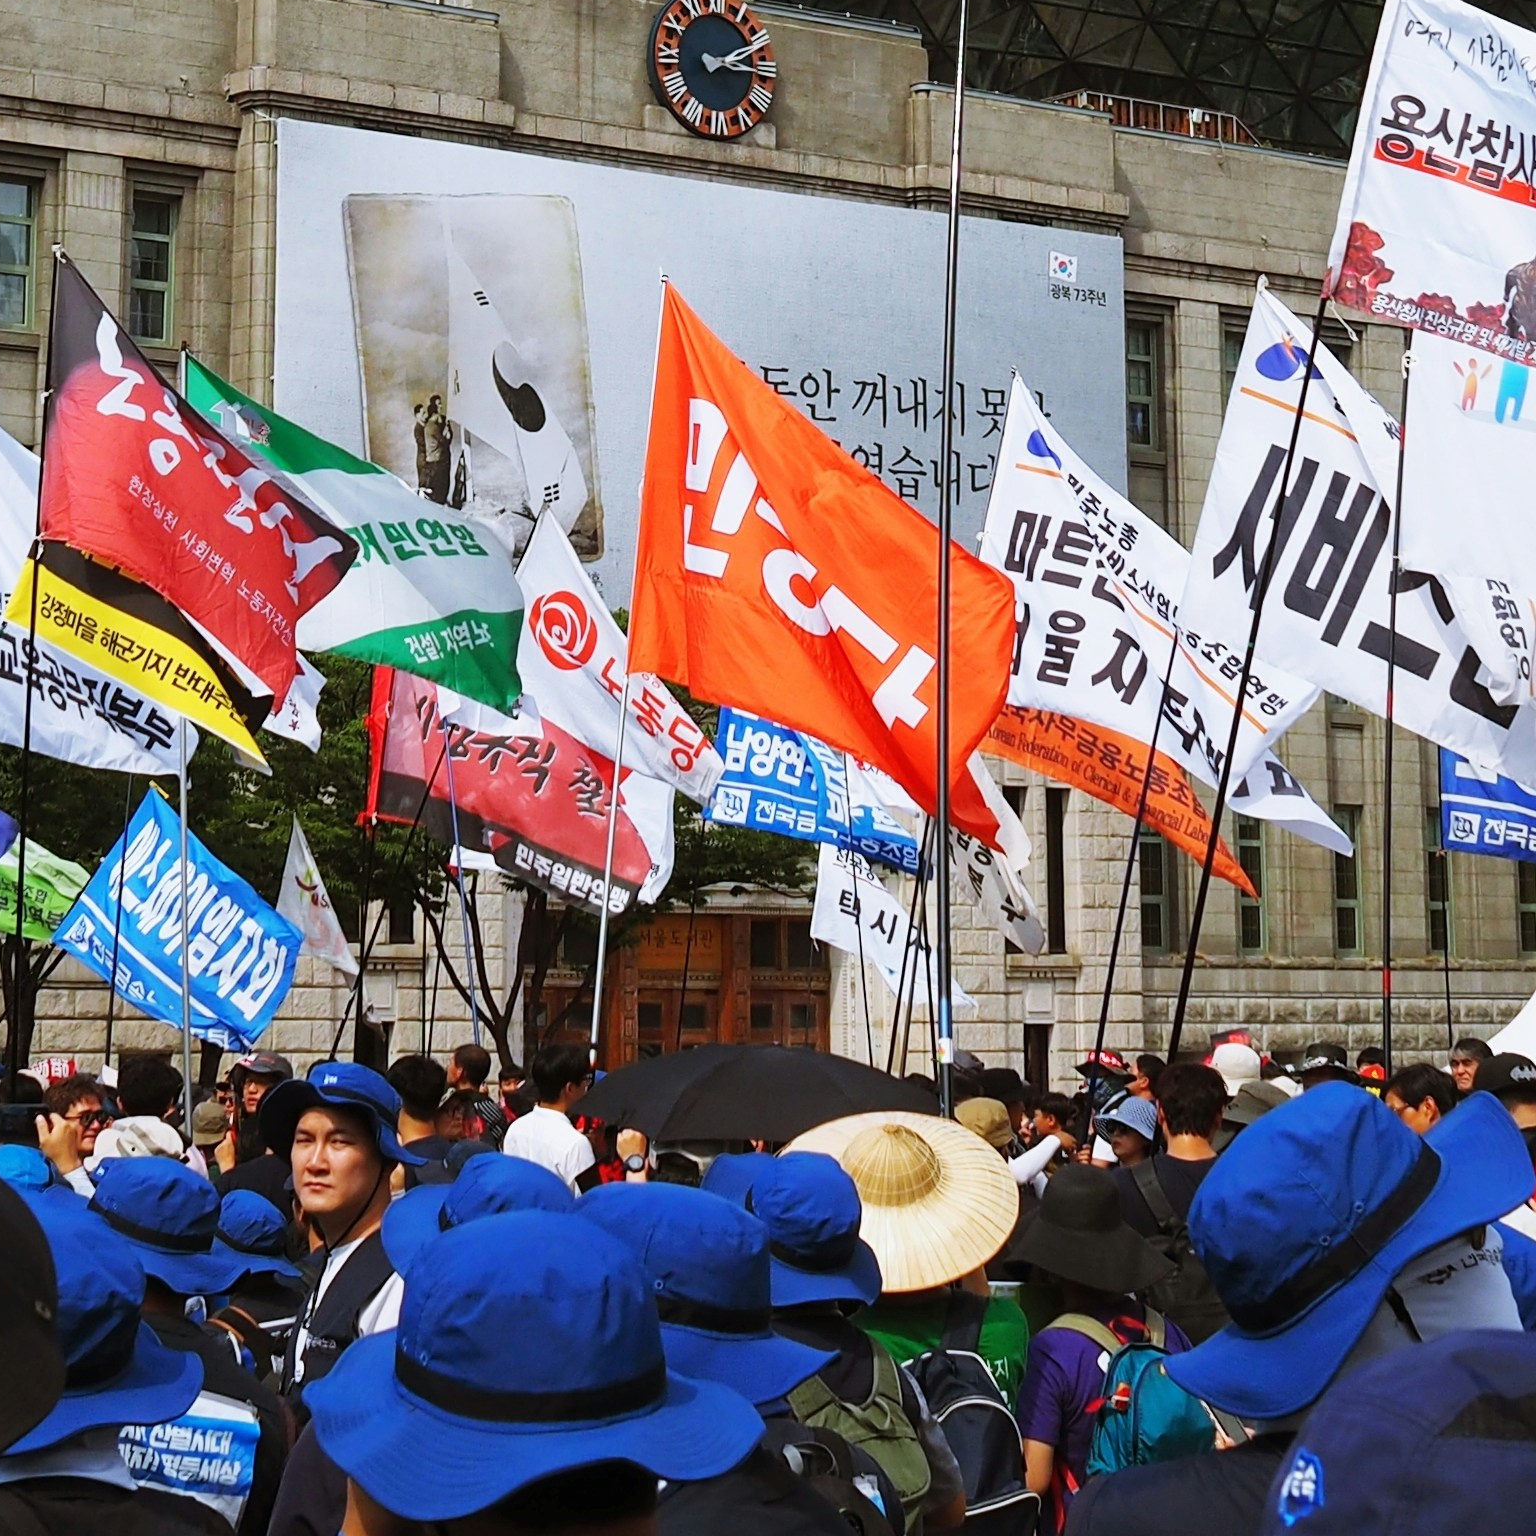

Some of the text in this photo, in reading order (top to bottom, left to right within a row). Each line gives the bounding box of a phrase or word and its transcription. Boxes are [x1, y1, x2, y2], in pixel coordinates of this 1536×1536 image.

[1050, 283, 1108, 308] 광복 73주년
[1371, 293, 1425, 327] 용산참사
[1425, 308, 1478, 343] 진상규명
[851, 372, 966, 437] 꺼내지
[180, 526, 237, 586] 사회변혁
[347, 516, 490, 569] 거민연합
[40, 591, 99, 645] 강정마을
[100, 627, 173, 682] 해군기지
